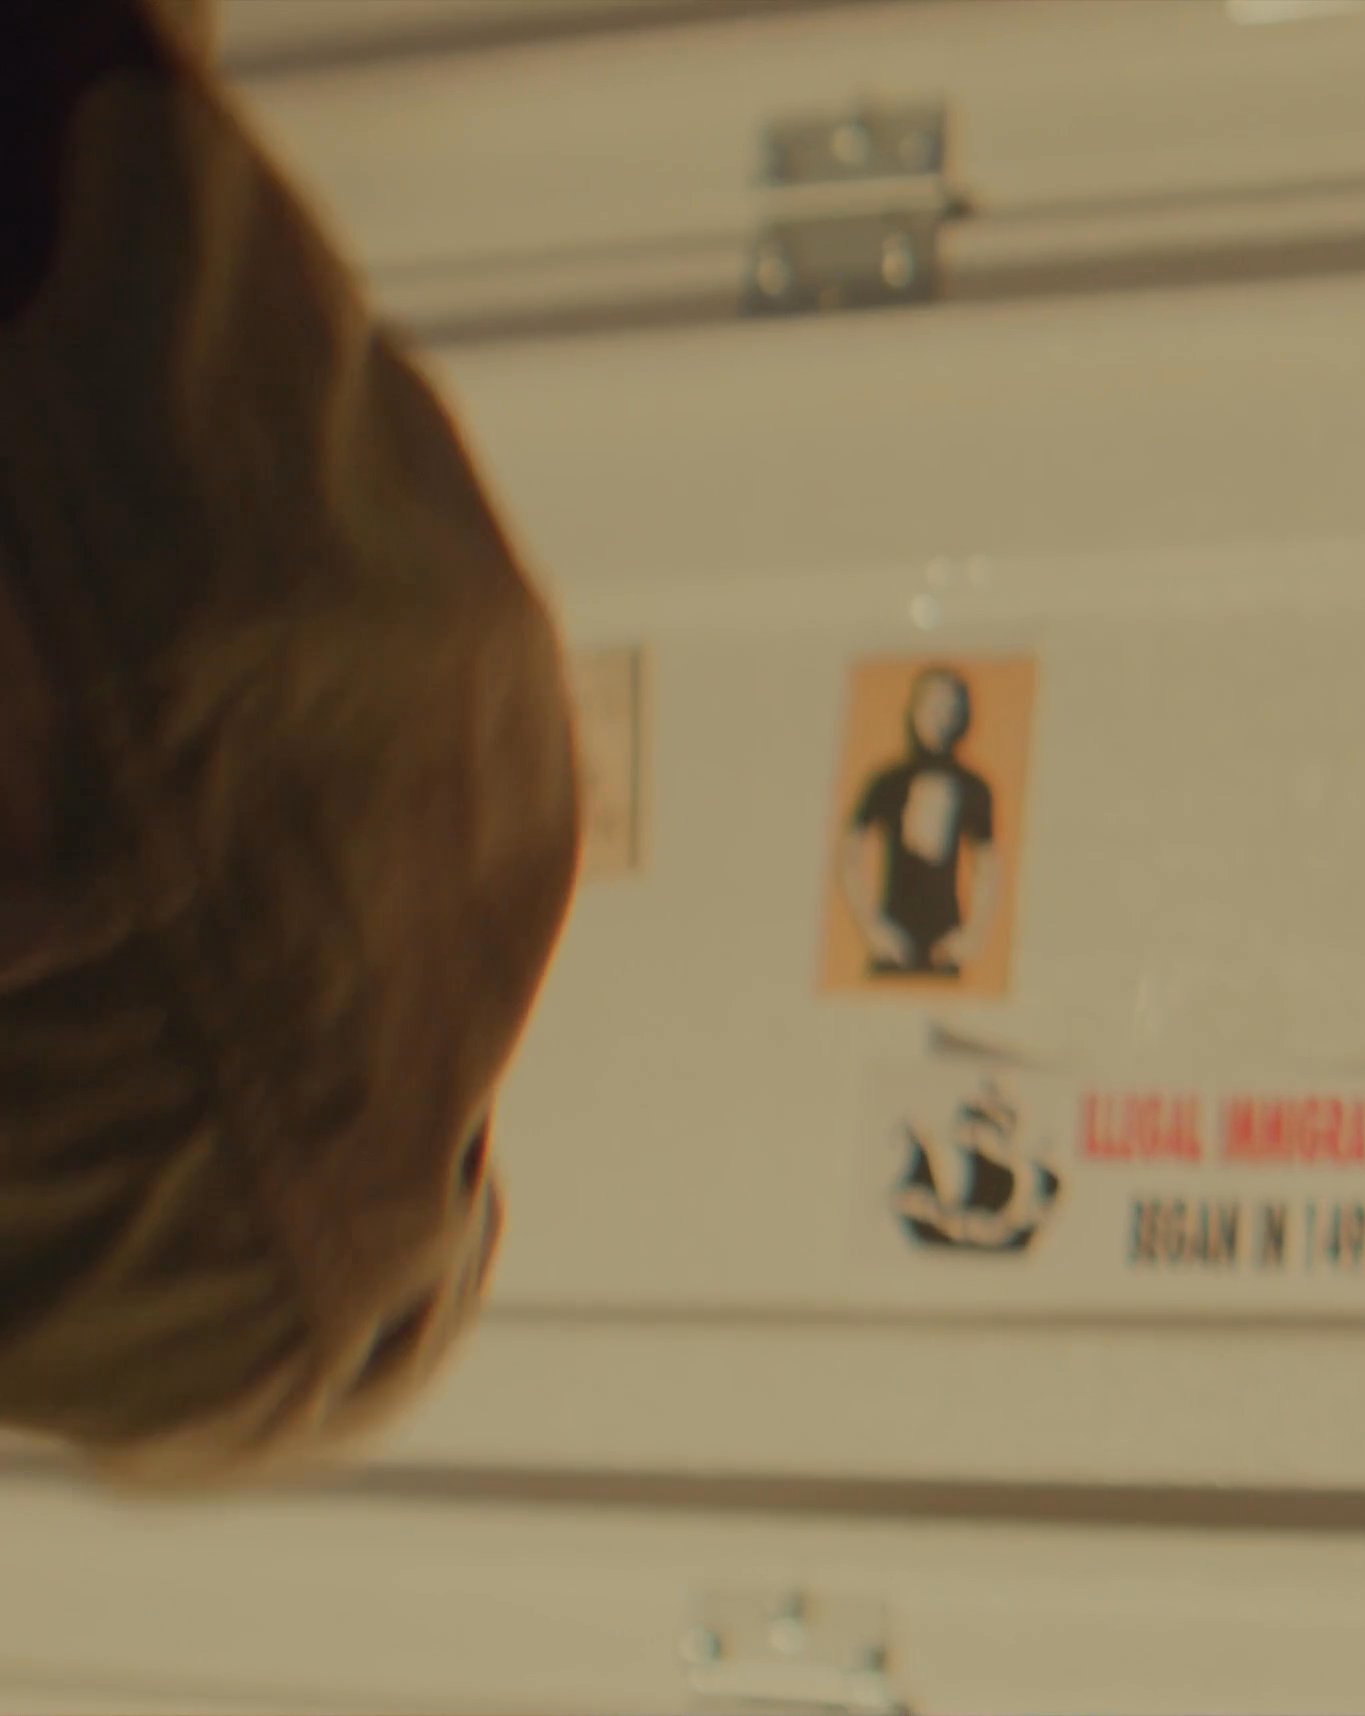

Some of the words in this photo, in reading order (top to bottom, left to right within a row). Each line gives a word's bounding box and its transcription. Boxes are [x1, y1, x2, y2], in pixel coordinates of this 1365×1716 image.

[1079, 1092, 1203, 1160] ILLEGAL
[1126, 1200, 1240, 1268] BEGAN
[1252, 1201, 1286, 1270] IN
